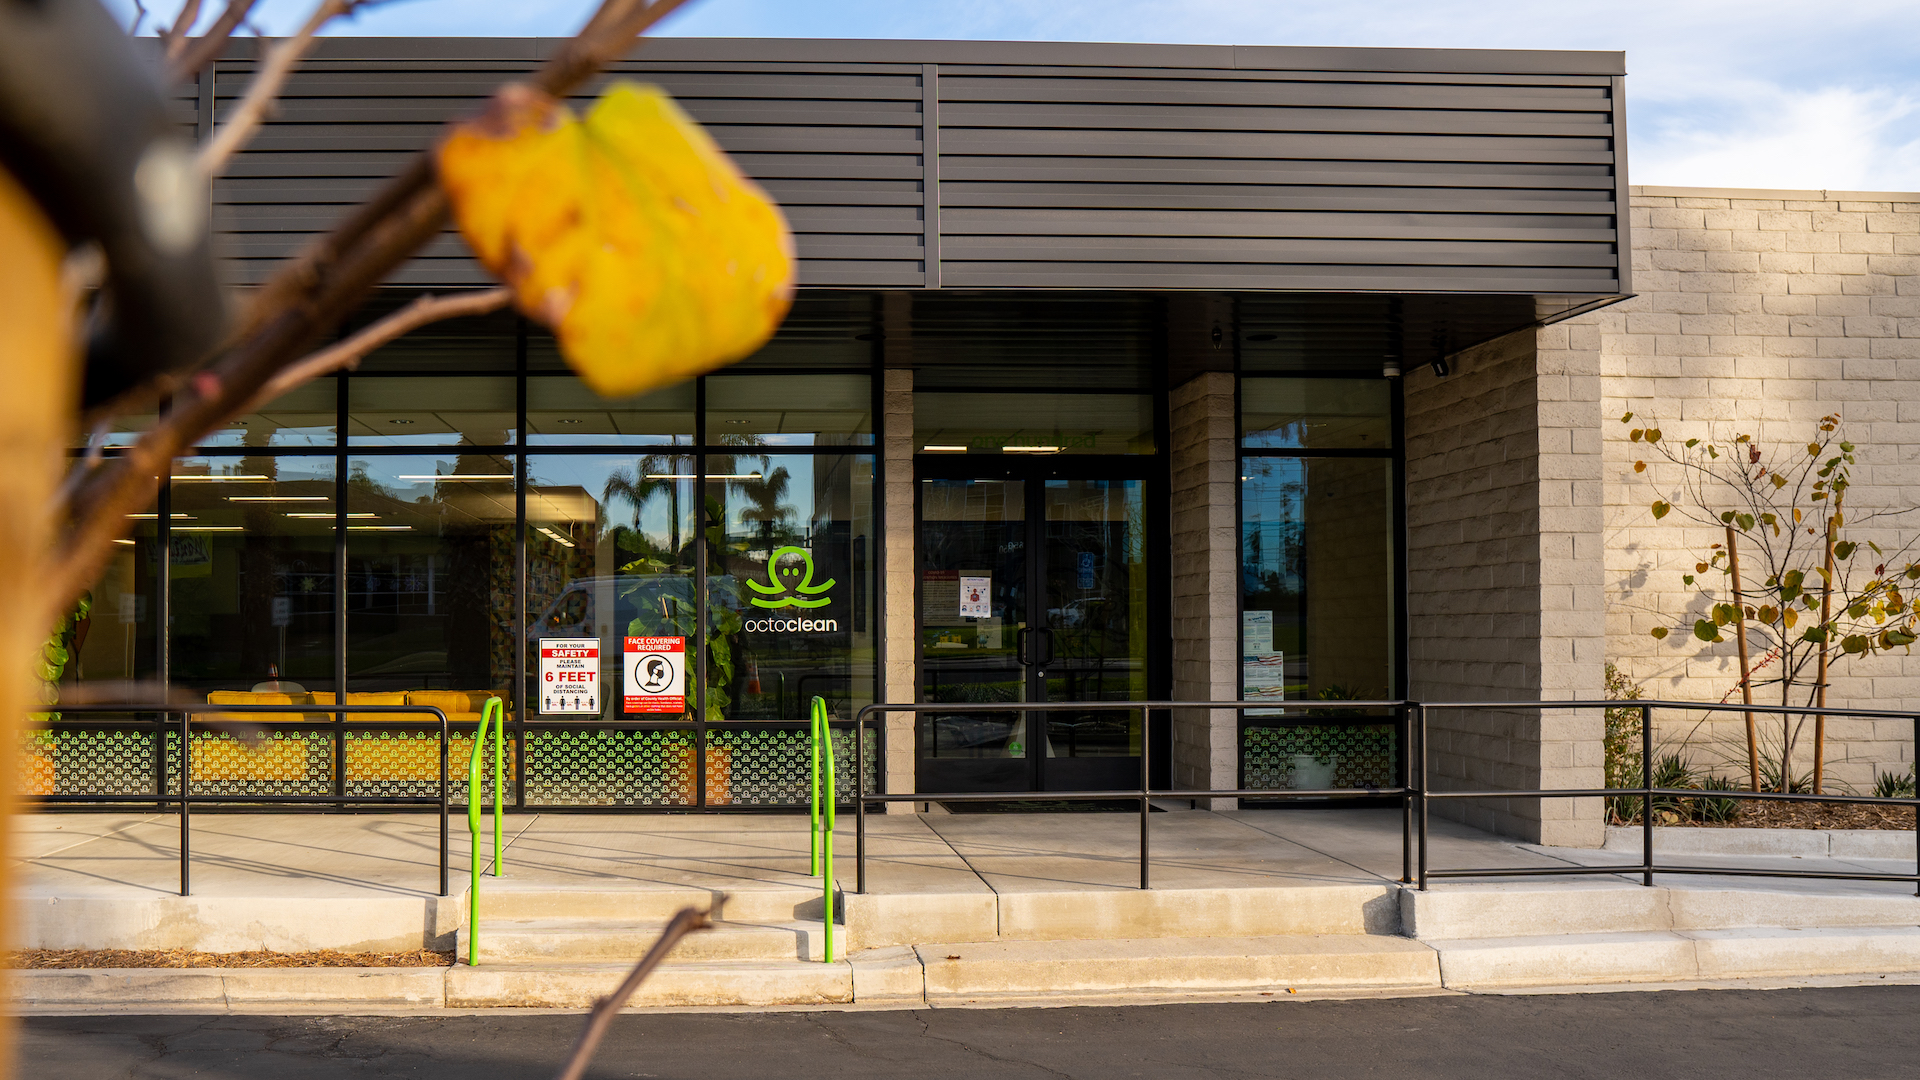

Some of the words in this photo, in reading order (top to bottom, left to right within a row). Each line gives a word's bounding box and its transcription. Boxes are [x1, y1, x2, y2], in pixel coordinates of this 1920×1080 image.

[745, 617, 838, 632] octoclean
[551, 649, 589, 657] SAFETY
[545, 671, 554, 682] 6
[559, 671, 596, 682] FEET
